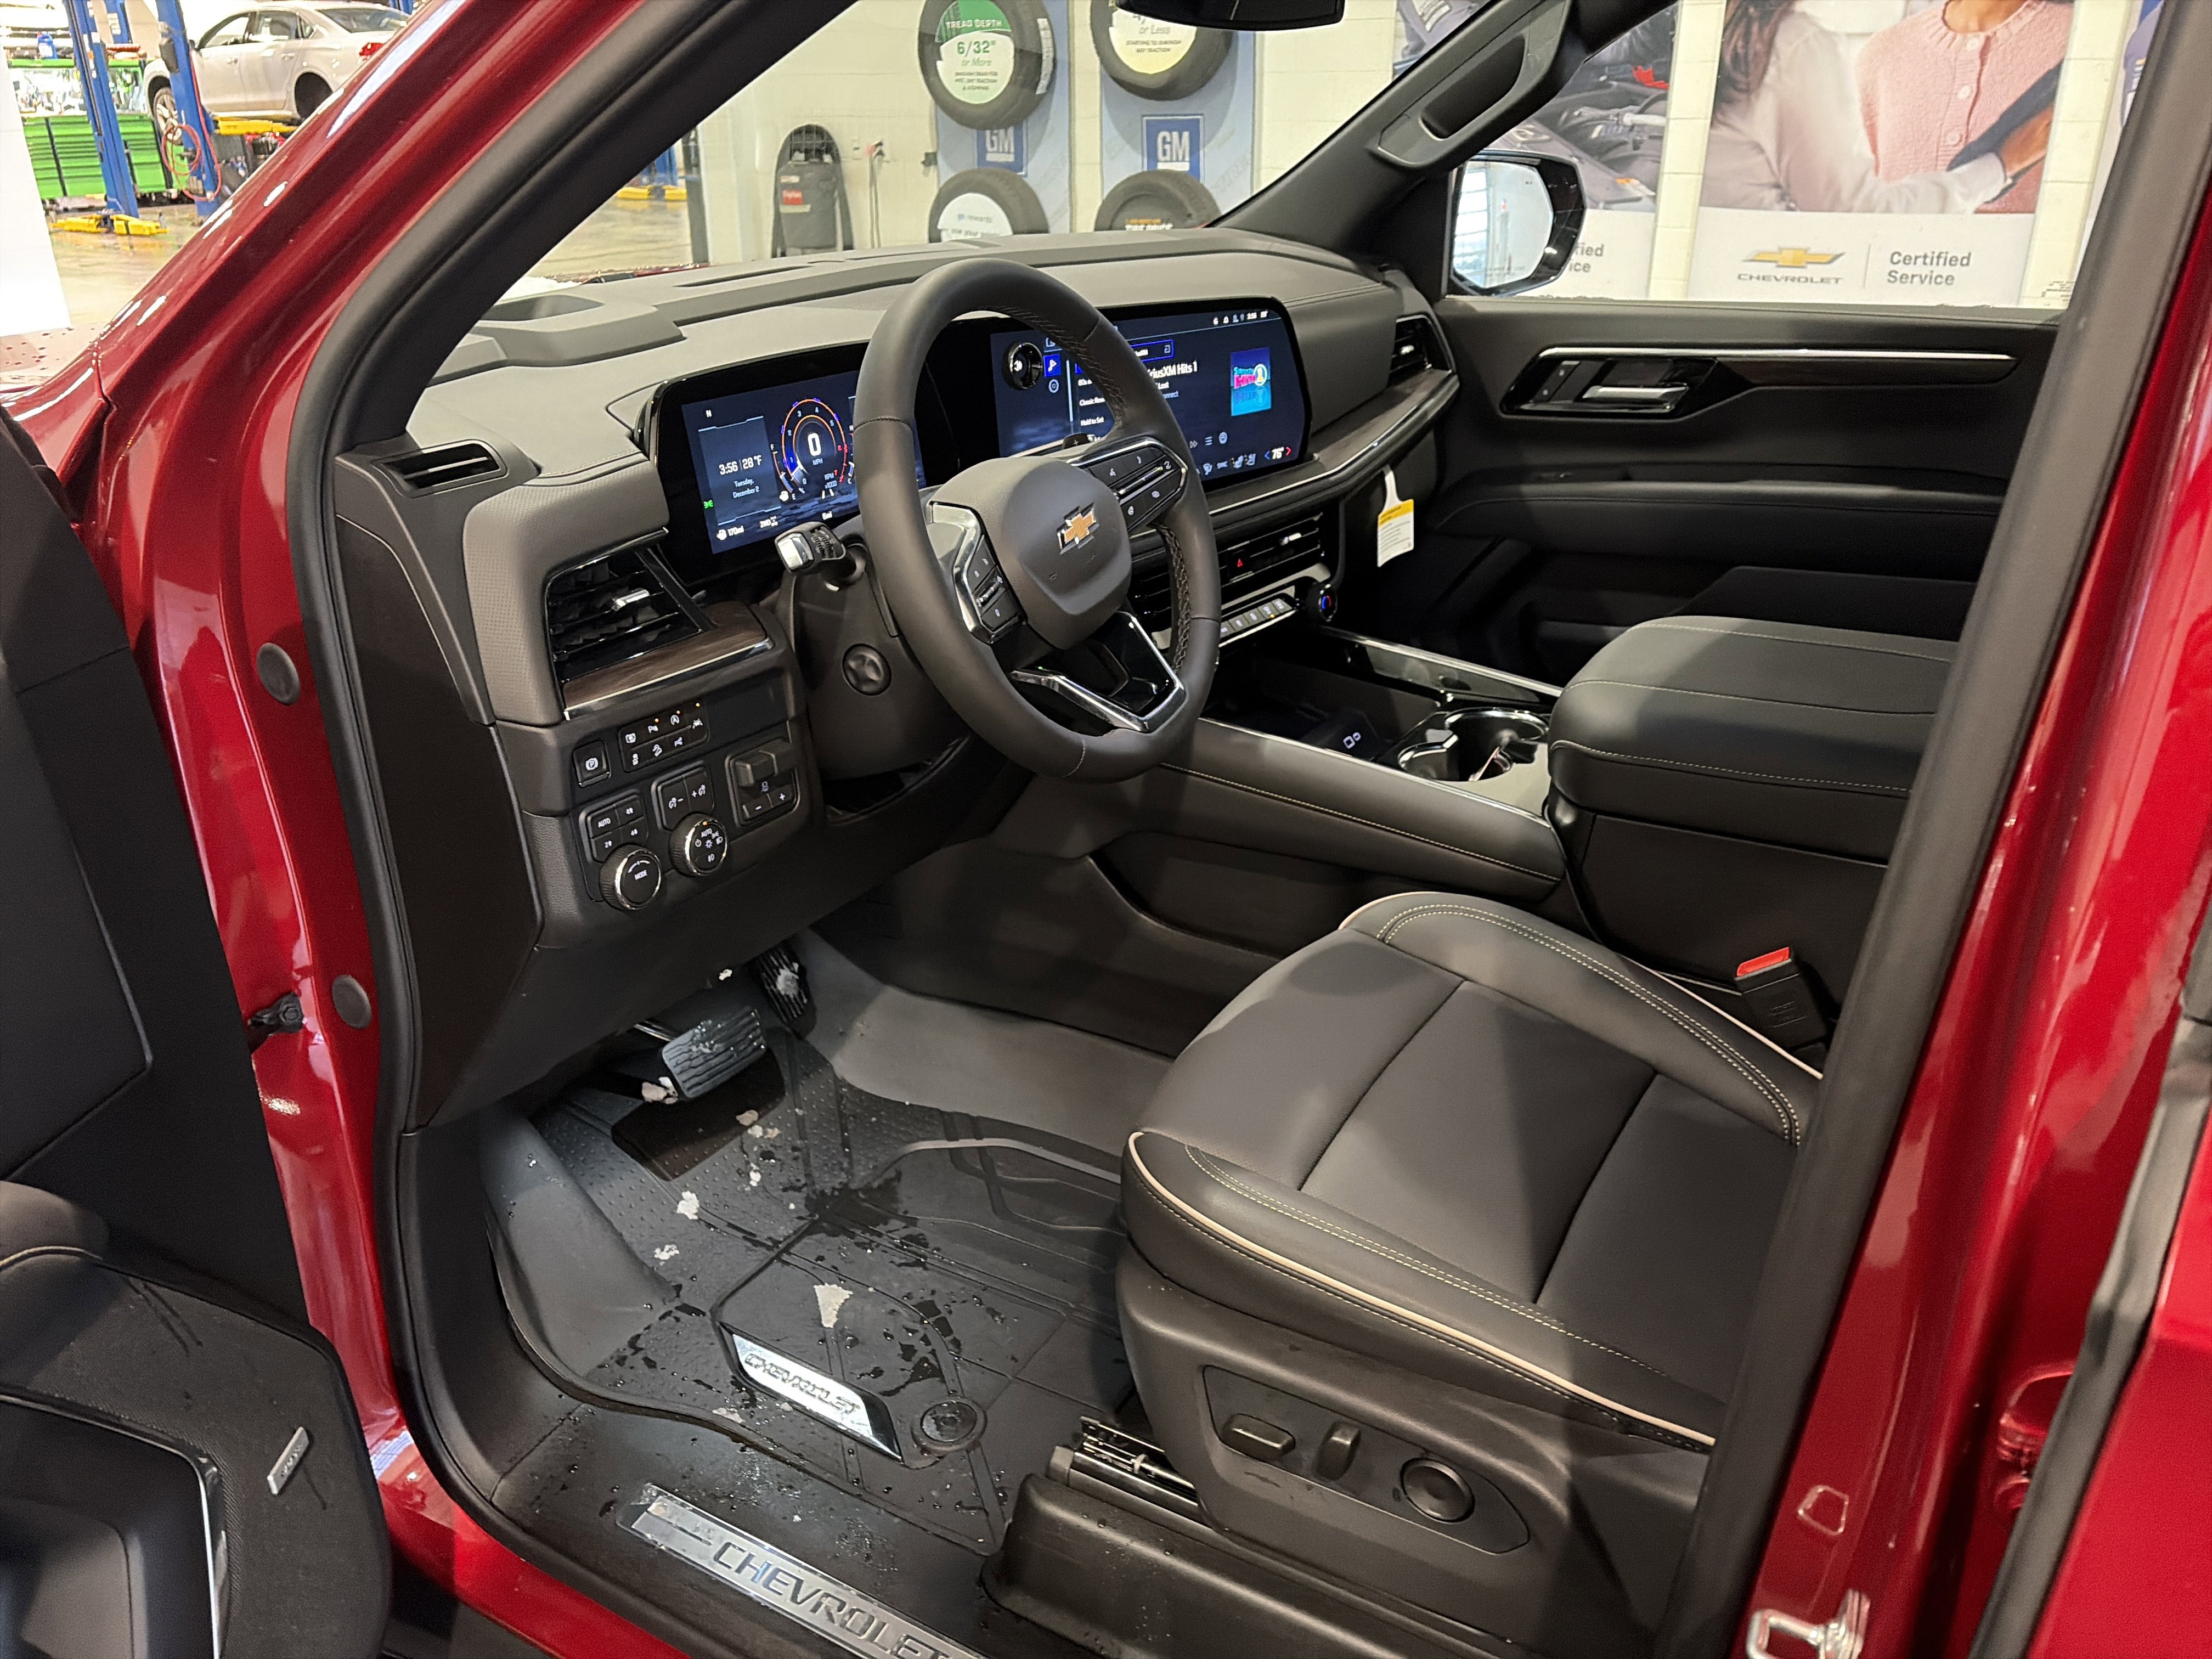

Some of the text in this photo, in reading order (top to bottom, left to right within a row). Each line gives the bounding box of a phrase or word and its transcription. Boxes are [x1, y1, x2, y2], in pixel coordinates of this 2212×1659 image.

[985, 127, 1014, 153] GM
[1157, 131, 1189, 161] GM
[1889, 251, 1972, 267] Certified
[1736, 273, 1843, 284] CHEVROLET
[1887, 269, 1955, 285] Service
[1177, 363, 1193, 374] Hits
[1193, 360, 1198, 372] 1
[706, 410, 713, 418] N
[808, 433, 821, 456] 0
[719, 461, 738, 475] 3:56
[733, 478, 754, 488] Tuesday,
[733, 488, 755, 499] December
[598, 817, 611, 828] AUTO
[701, 828, 713, 838] AUTO
[635, 870, 648, 880] MODE
[744, 1353, 861, 1414] CHEVROLET
